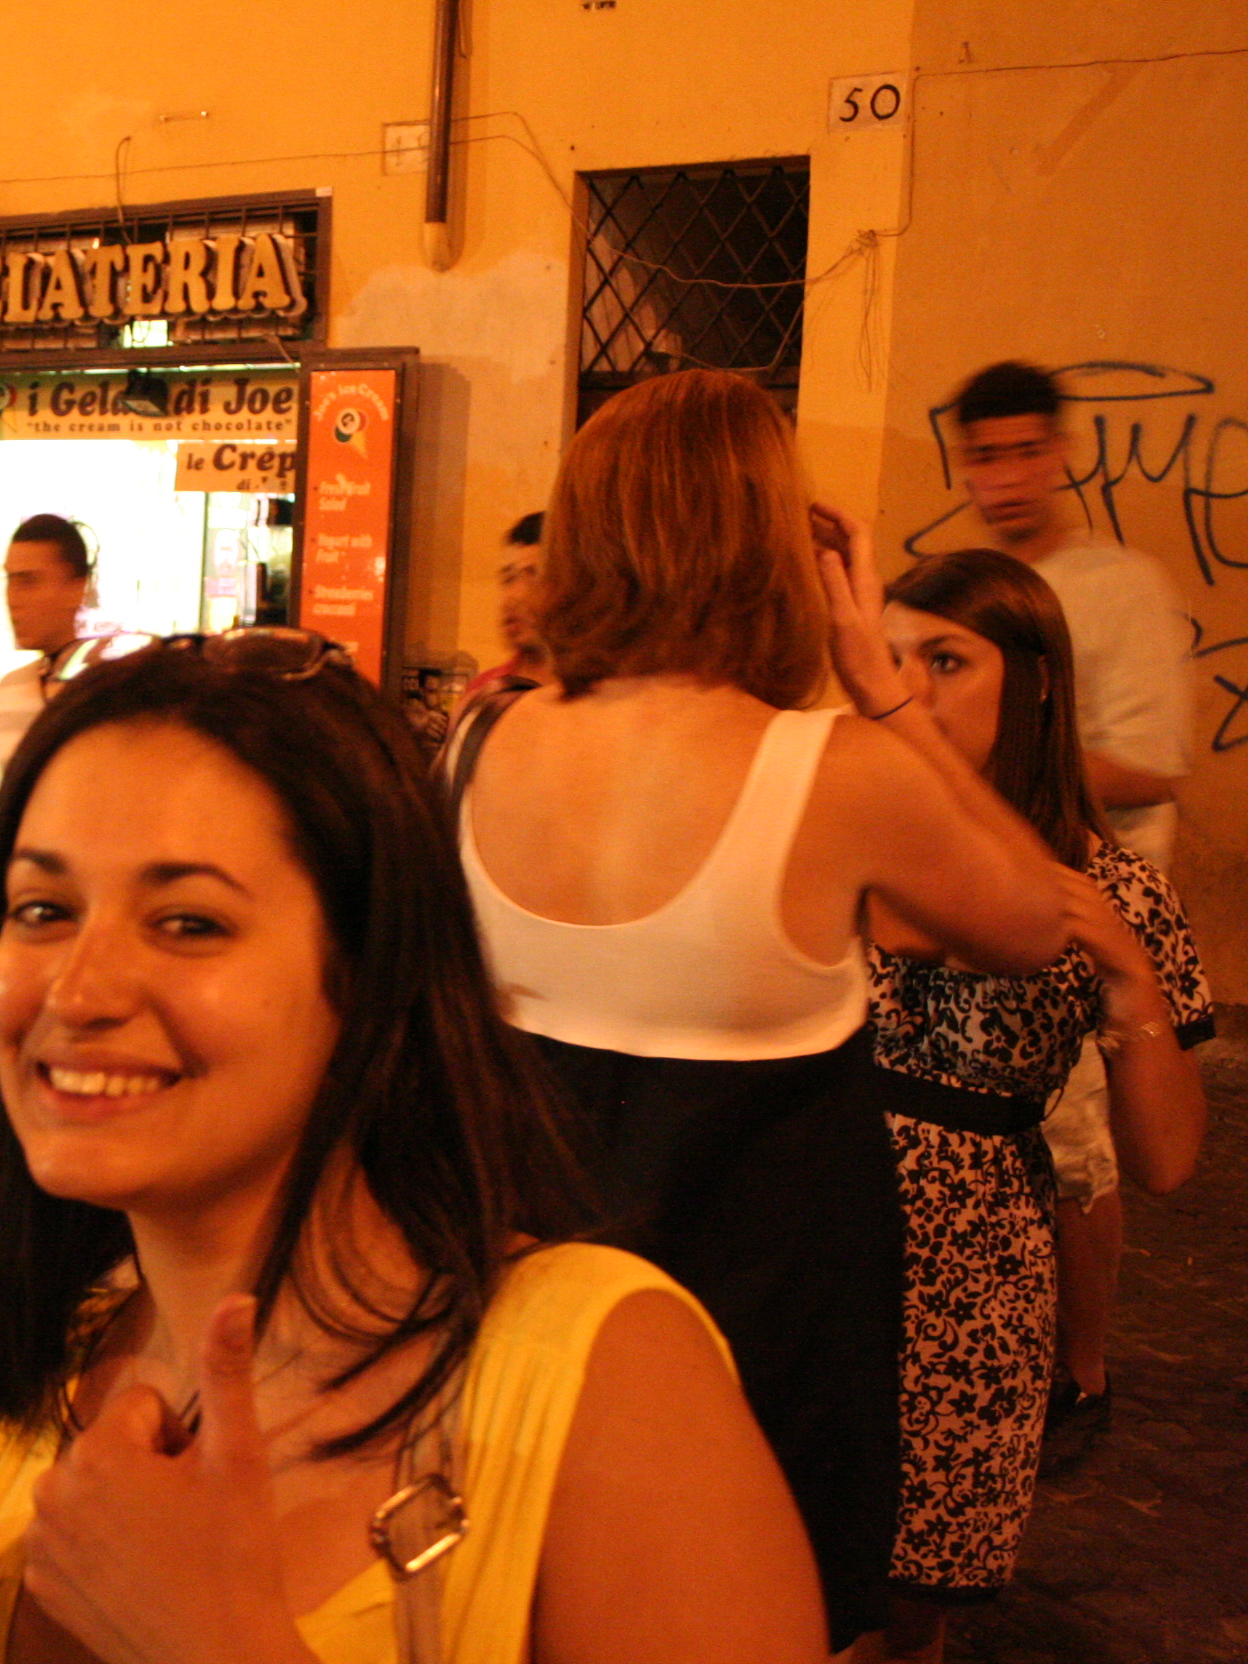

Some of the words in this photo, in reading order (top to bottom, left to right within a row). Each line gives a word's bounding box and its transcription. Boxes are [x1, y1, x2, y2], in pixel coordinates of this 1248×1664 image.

[838, 83, 901, 122] 50
[28, 381, 39, 416] i
[173, 378, 212, 416] di
[223, 377, 294, 415] Joe
[69, 422, 120, 432] cream
[129, 420, 144, 432] is
[153, 420, 182, 432] not
[186, 452, 205, 470] le
